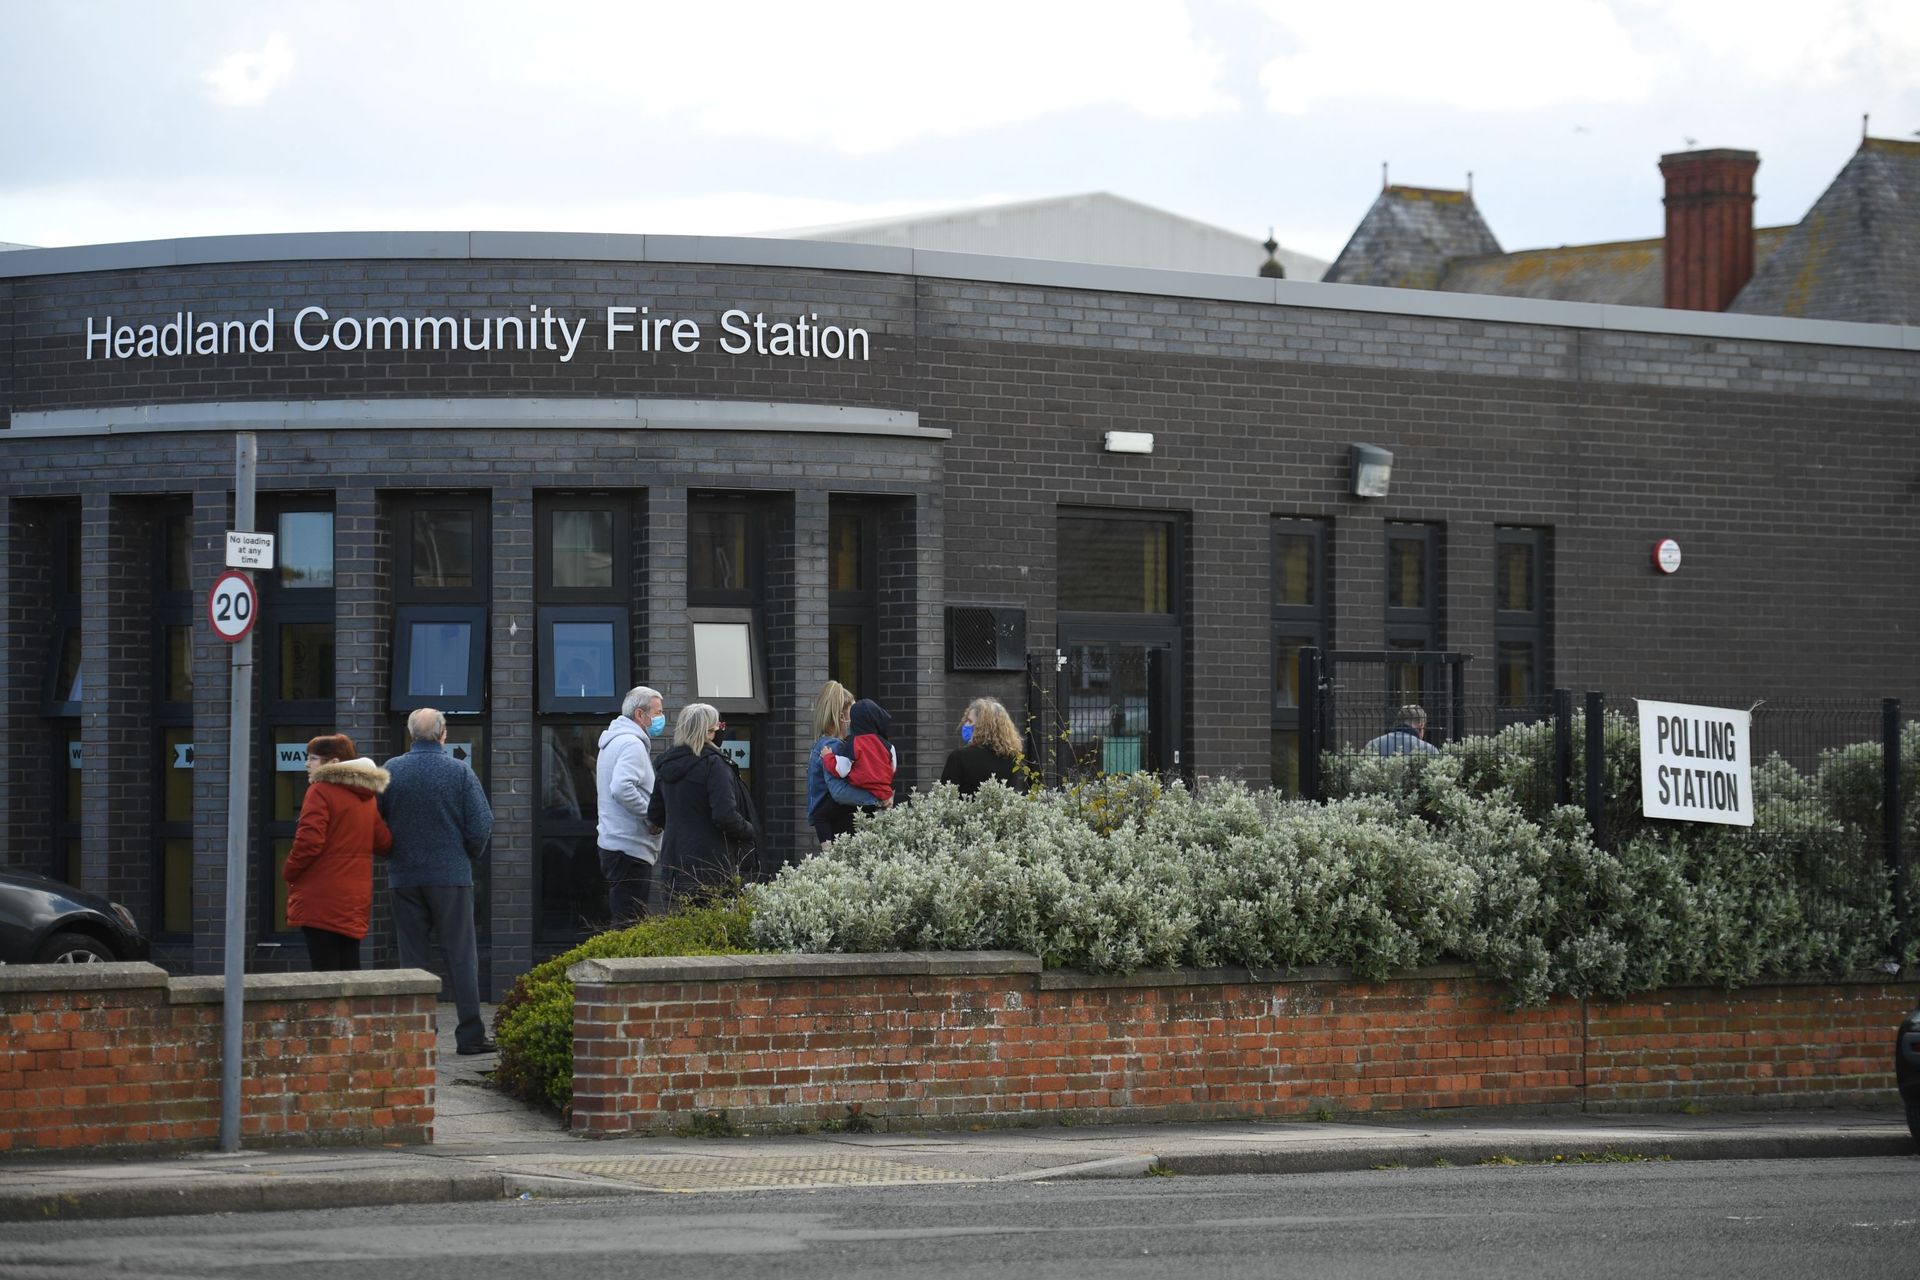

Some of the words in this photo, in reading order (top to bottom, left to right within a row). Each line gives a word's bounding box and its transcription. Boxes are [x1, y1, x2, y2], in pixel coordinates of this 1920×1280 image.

[86, 306, 275, 361] Headland
[293, 305, 587, 363] Community
[607, 306, 700, 353] Fire
[719, 309, 869, 361] Station
[229, 535, 241, 544] No
[243, 537, 270, 547] loading
[238, 546, 247, 554] at
[248, 548, 262, 556] any
[241, 556, 258, 564] time
[216, 591, 250, 621] 20
[1657, 715, 1736, 762] POLLING
[280, 751, 309, 762] WAY
[1658, 764, 1739, 812] STATION
